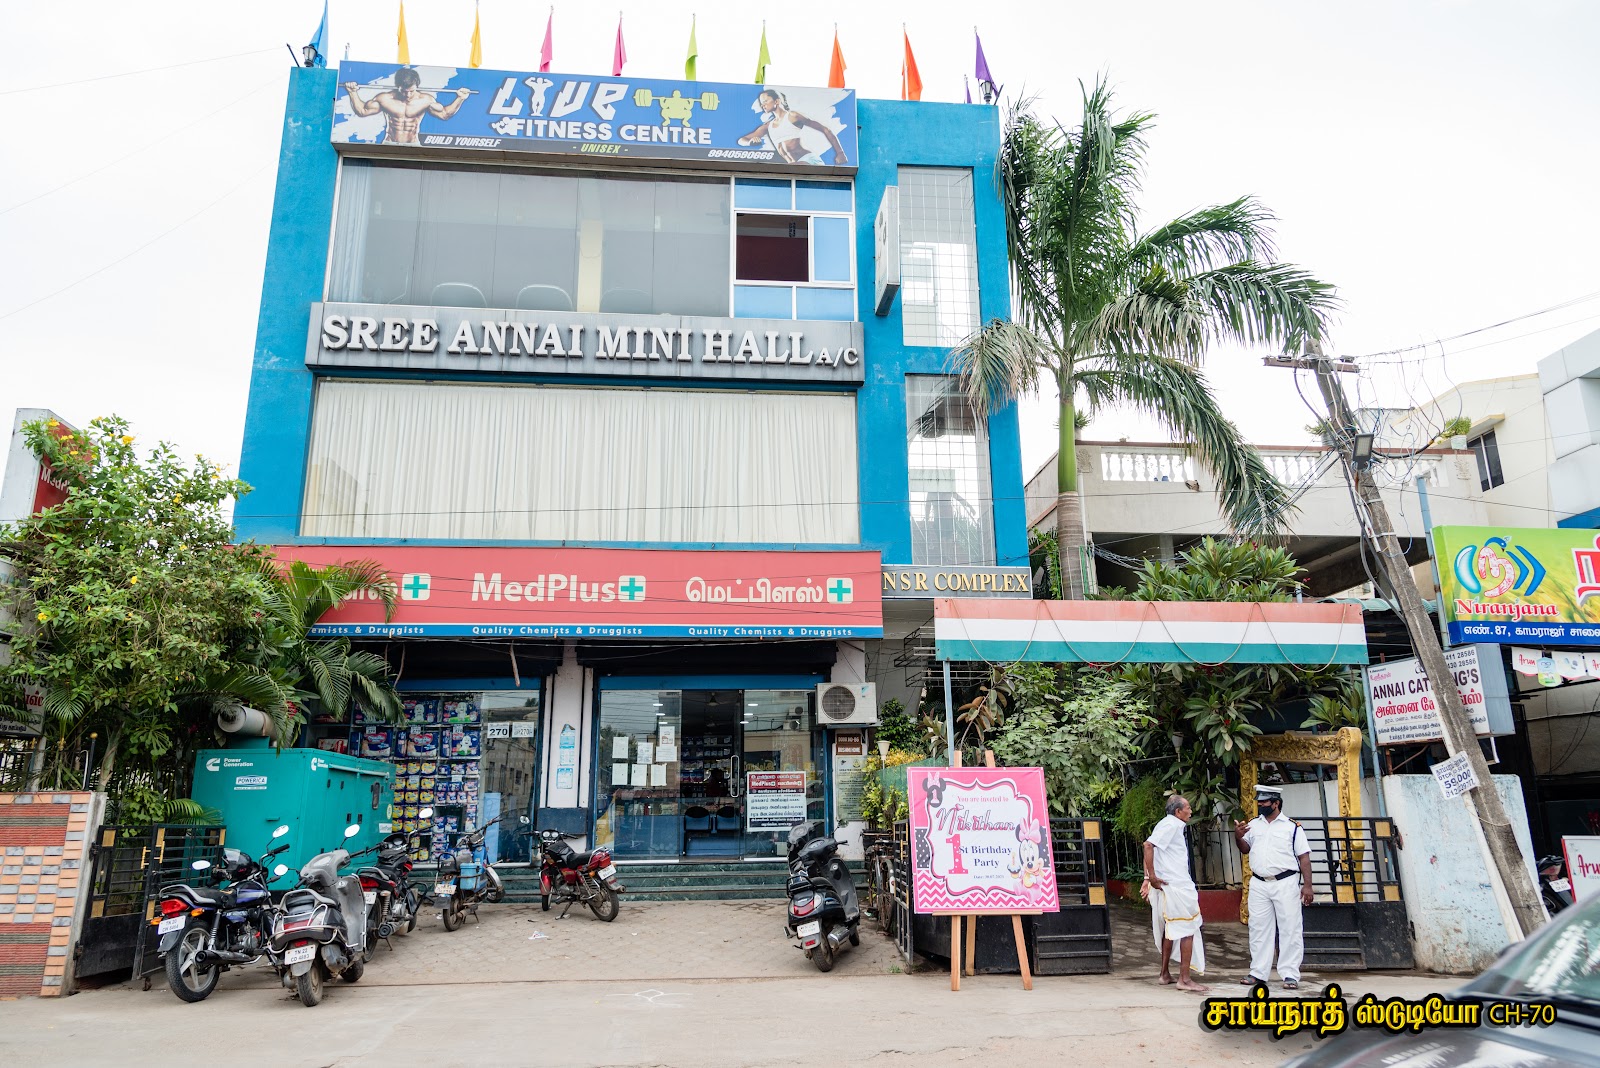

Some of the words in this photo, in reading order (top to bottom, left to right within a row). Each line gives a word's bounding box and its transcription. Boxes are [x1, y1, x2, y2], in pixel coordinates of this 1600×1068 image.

[511, 119, 612, 140] FITNESS
[619, 125, 712, 145] CENTRE
[424, 136, 451, 145] BUILD
[454, 137, 501, 147] YOURSELF
[580, 143, 621, 154] UNISEX
[322, 315, 440, 353] SREE
[448, 322, 584, 358] ANNAI
[596, 326, 692, 362] MINI
[703, 330, 815, 365] HALL
[815, 347, 858, 368] A/C
[471, 572, 617, 603] MedPlus
[934, 573, 1029, 592] COMPLEX
[685, 576, 824, 603] மெட்பிளஸ்
[1455, 599, 1560, 622] Niranjana
[368, 626, 424, 637] Druggists
[472, 626, 514, 636] Quality
[520, 626, 570, 634] Chemists
[589, 627, 643, 636] Druggists
[688, 627, 729, 637] Quality
[734, 627, 783, 635] Chemists
[788, 628, 796, 636] &
[800, 628, 852, 637] Druggists
[1515, 625, 1565, 638] காமராஜர்
[1519, 654, 1536, 666] Arun
[1373, 681, 1406, 700] ANNAI
[1376, 700, 1419, 718] அன்னை
[490, 728, 508, 736] 270
[971, 845, 1013, 857] Birthday
[974, 858, 1000, 869] Party
